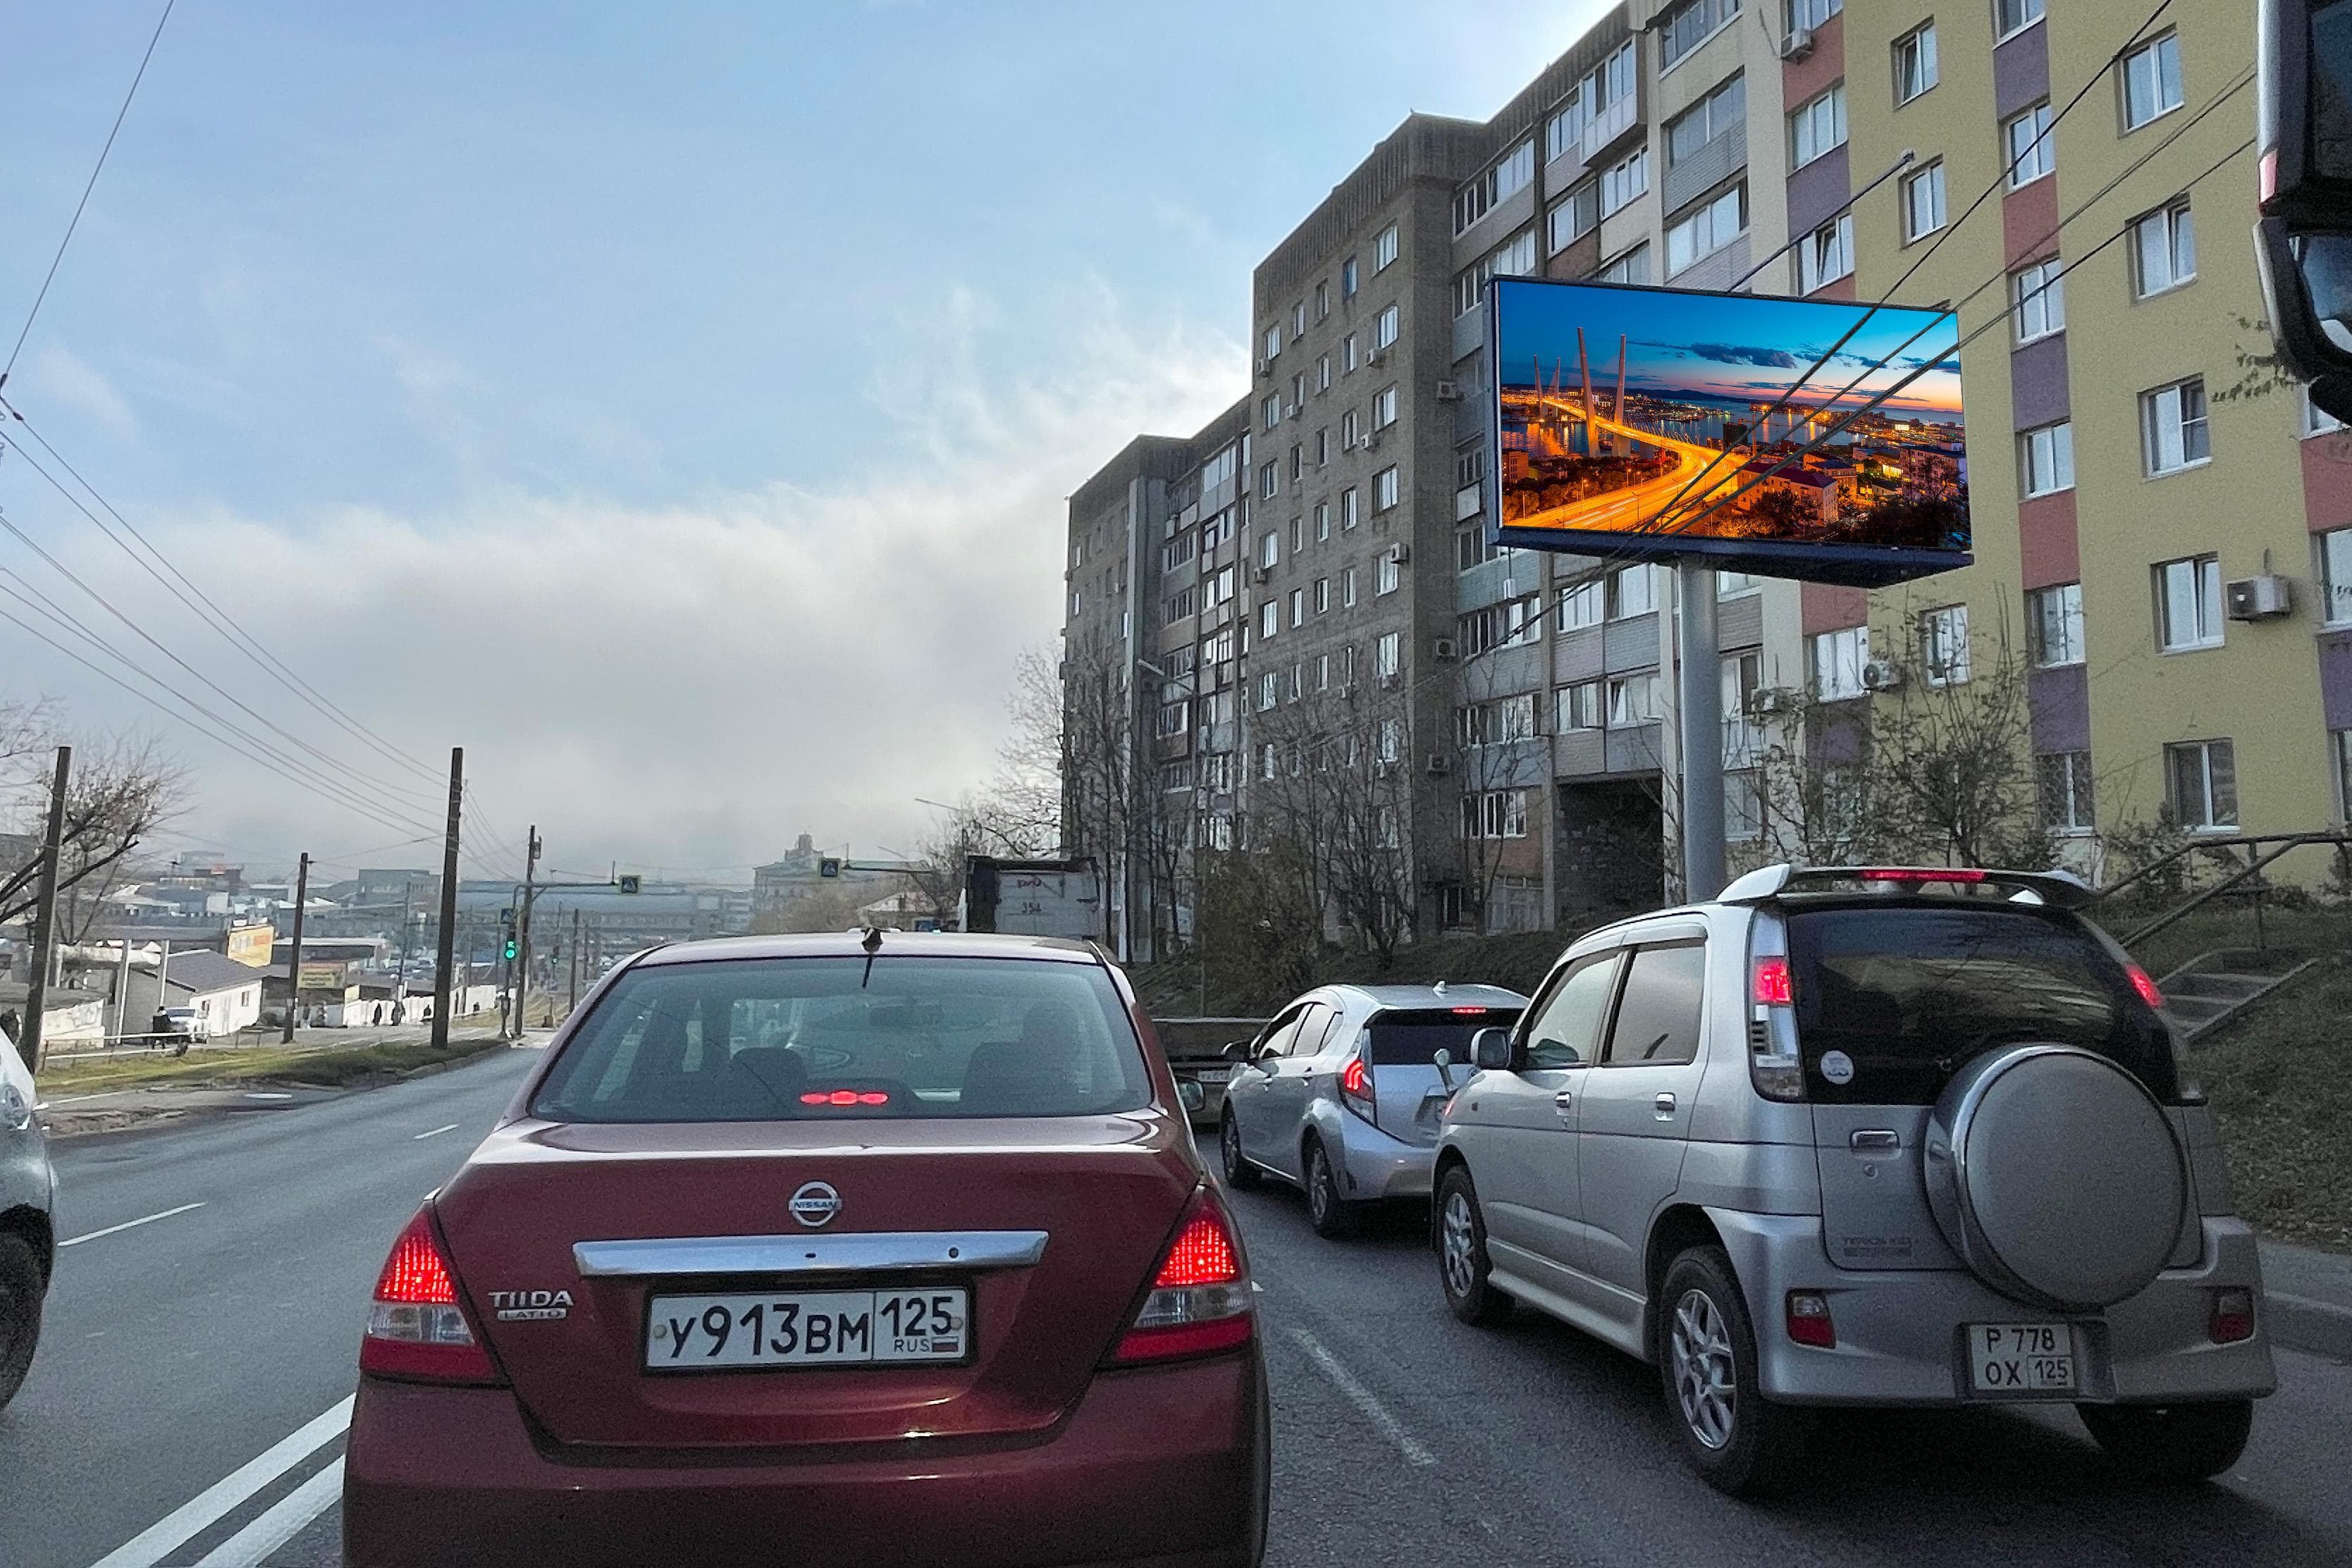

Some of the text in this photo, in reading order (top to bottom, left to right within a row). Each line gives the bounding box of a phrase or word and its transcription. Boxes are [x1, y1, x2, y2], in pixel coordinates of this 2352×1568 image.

[487, 1290, 574, 1307] TIIDA
[504, 1311, 562, 1320] LATIO
[881, 1295, 954, 1338] 125
[893, 1338, 930, 1353] RUS
[2011, 1327, 2055, 1351] 778
[2034, 1359, 2068, 1379] 125
